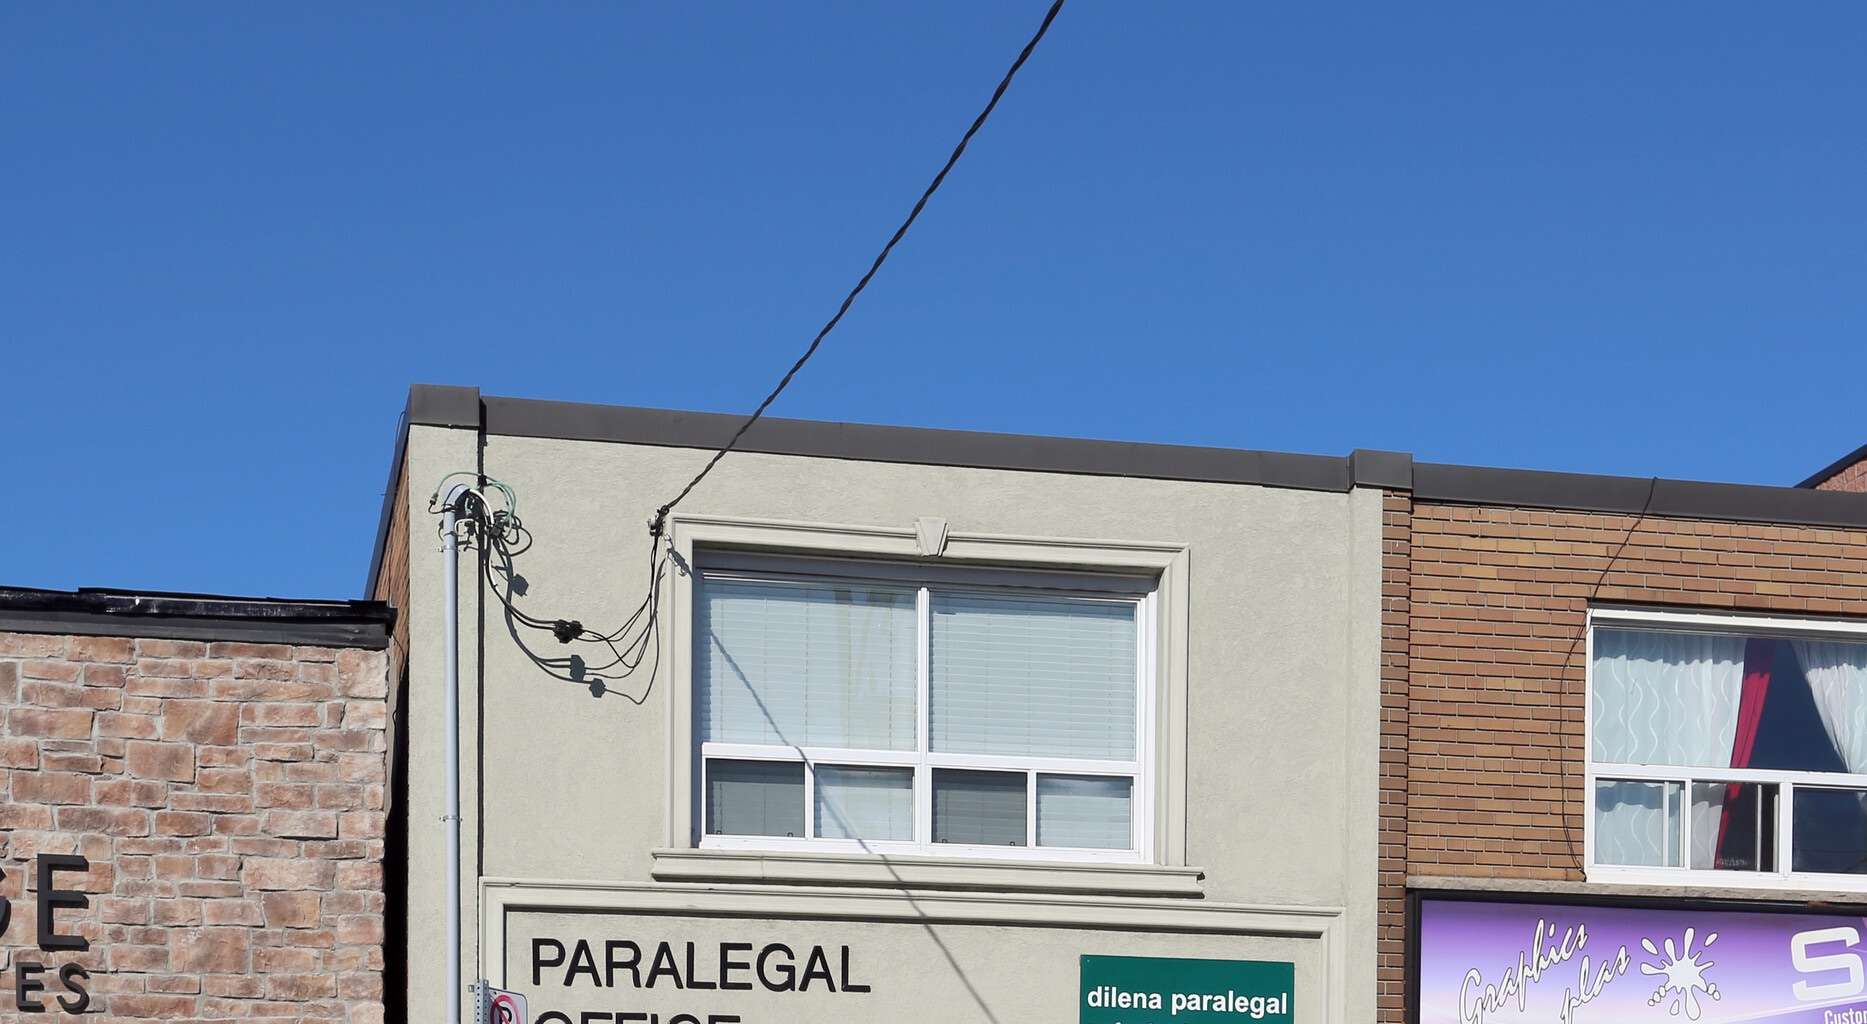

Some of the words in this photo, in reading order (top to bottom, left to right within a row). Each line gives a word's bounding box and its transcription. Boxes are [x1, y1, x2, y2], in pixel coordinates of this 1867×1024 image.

[531, 937, 872, 994] PARALEGAL
[1087, 985, 1162, 1010] dilena
[1171, 990, 1287, 1019] paralegal
